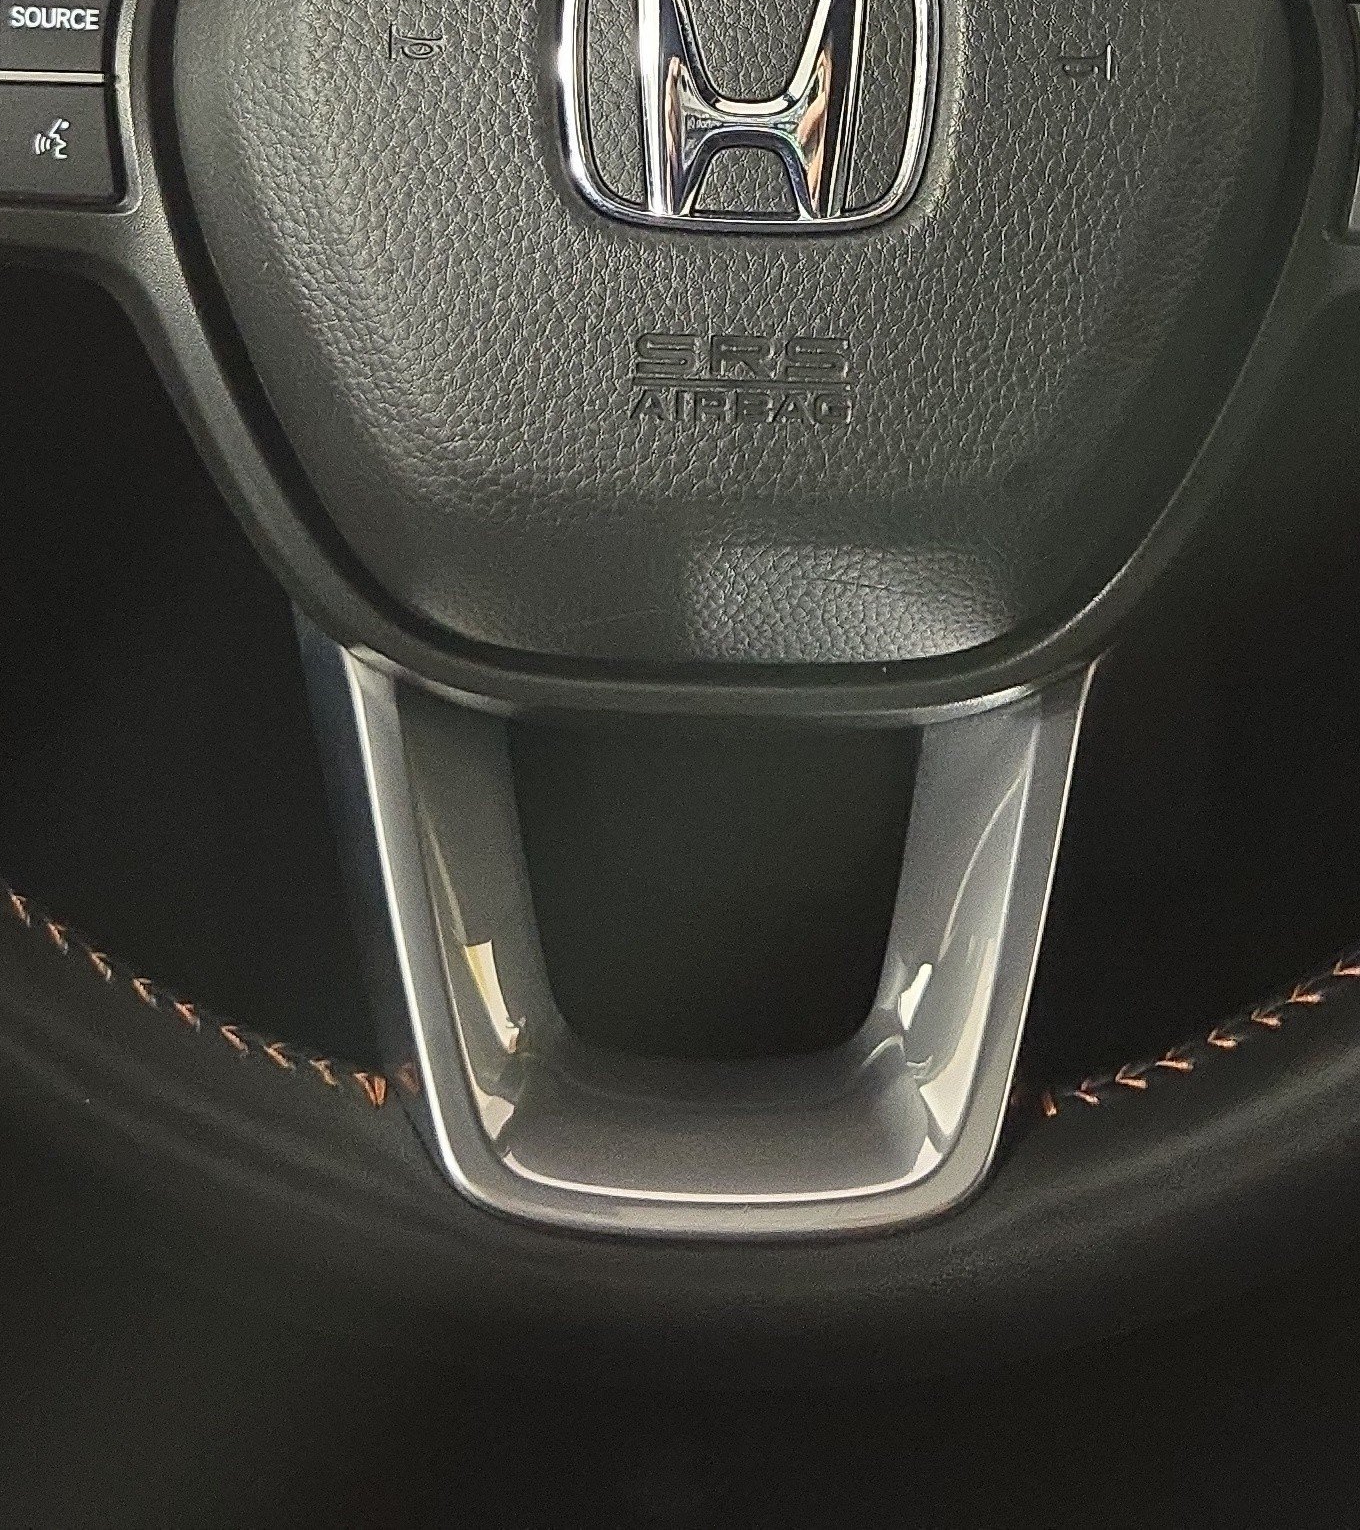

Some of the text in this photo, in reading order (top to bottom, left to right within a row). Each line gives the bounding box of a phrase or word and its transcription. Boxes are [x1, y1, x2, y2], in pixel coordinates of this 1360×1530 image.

[10, 6, 100, 31] SOURCE
[637, 333, 849, 377] SRS
[629, 388, 853, 424] AIRBAG
